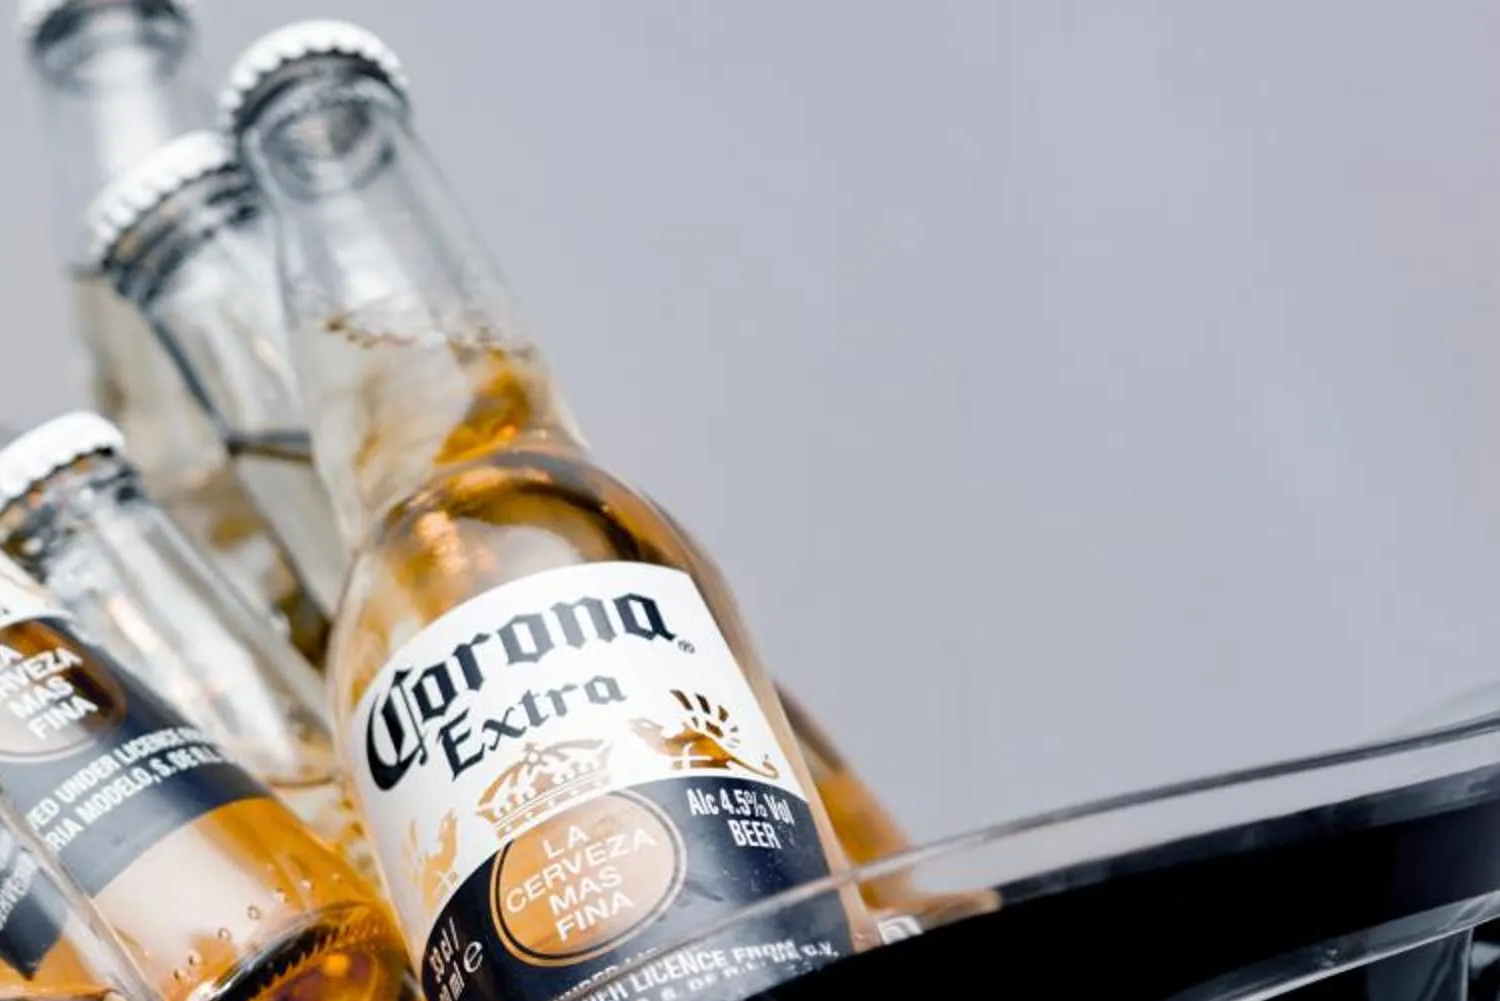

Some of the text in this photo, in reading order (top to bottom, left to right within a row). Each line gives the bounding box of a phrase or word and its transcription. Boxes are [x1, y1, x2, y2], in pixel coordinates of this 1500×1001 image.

[7, 675, 74, 719] MAS
[365, 592, 677, 791] Corona
[27, 694, 99, 741] FINA
[437, 675, 628, 782] Extra
[54, 753, 121, 804] UNDER
[686, 787, 796, 827] Alc 4.5% Vol
[541, 823, 590, 860] LA
[727, 818, 783, 850] BEER
[505, 827, 659, 914] CERVEZA
[547, 865, 623, 917] MAS
[555, 891, 636, 943] FINA
[630, 948, 729, 995] LICENCE
